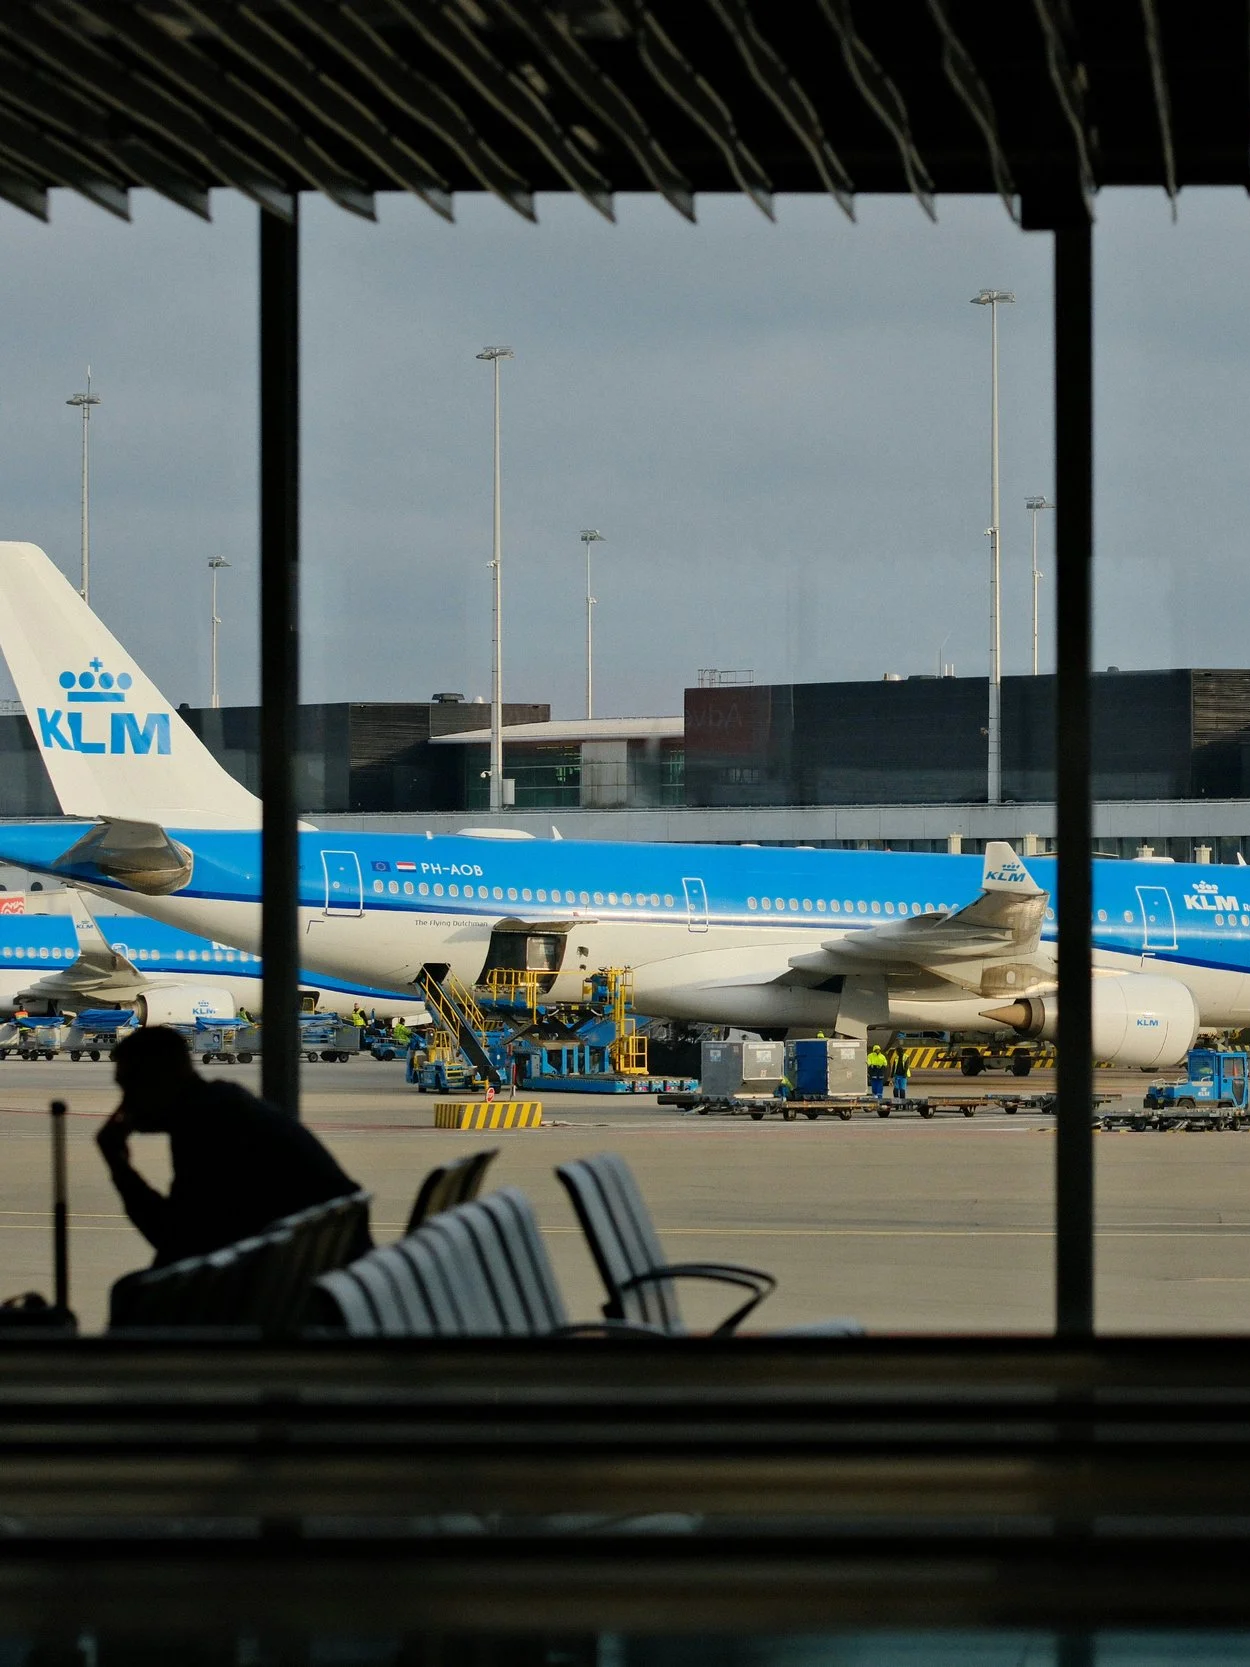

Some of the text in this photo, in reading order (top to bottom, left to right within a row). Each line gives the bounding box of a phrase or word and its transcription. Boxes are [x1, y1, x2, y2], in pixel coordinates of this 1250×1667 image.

[36, 707, 172, 755] KLM
[420, 862, 483, 877] PH-AOB
[985, 871, 1025, 882] KLM
[1183, 894, 1240, 911] KLM
